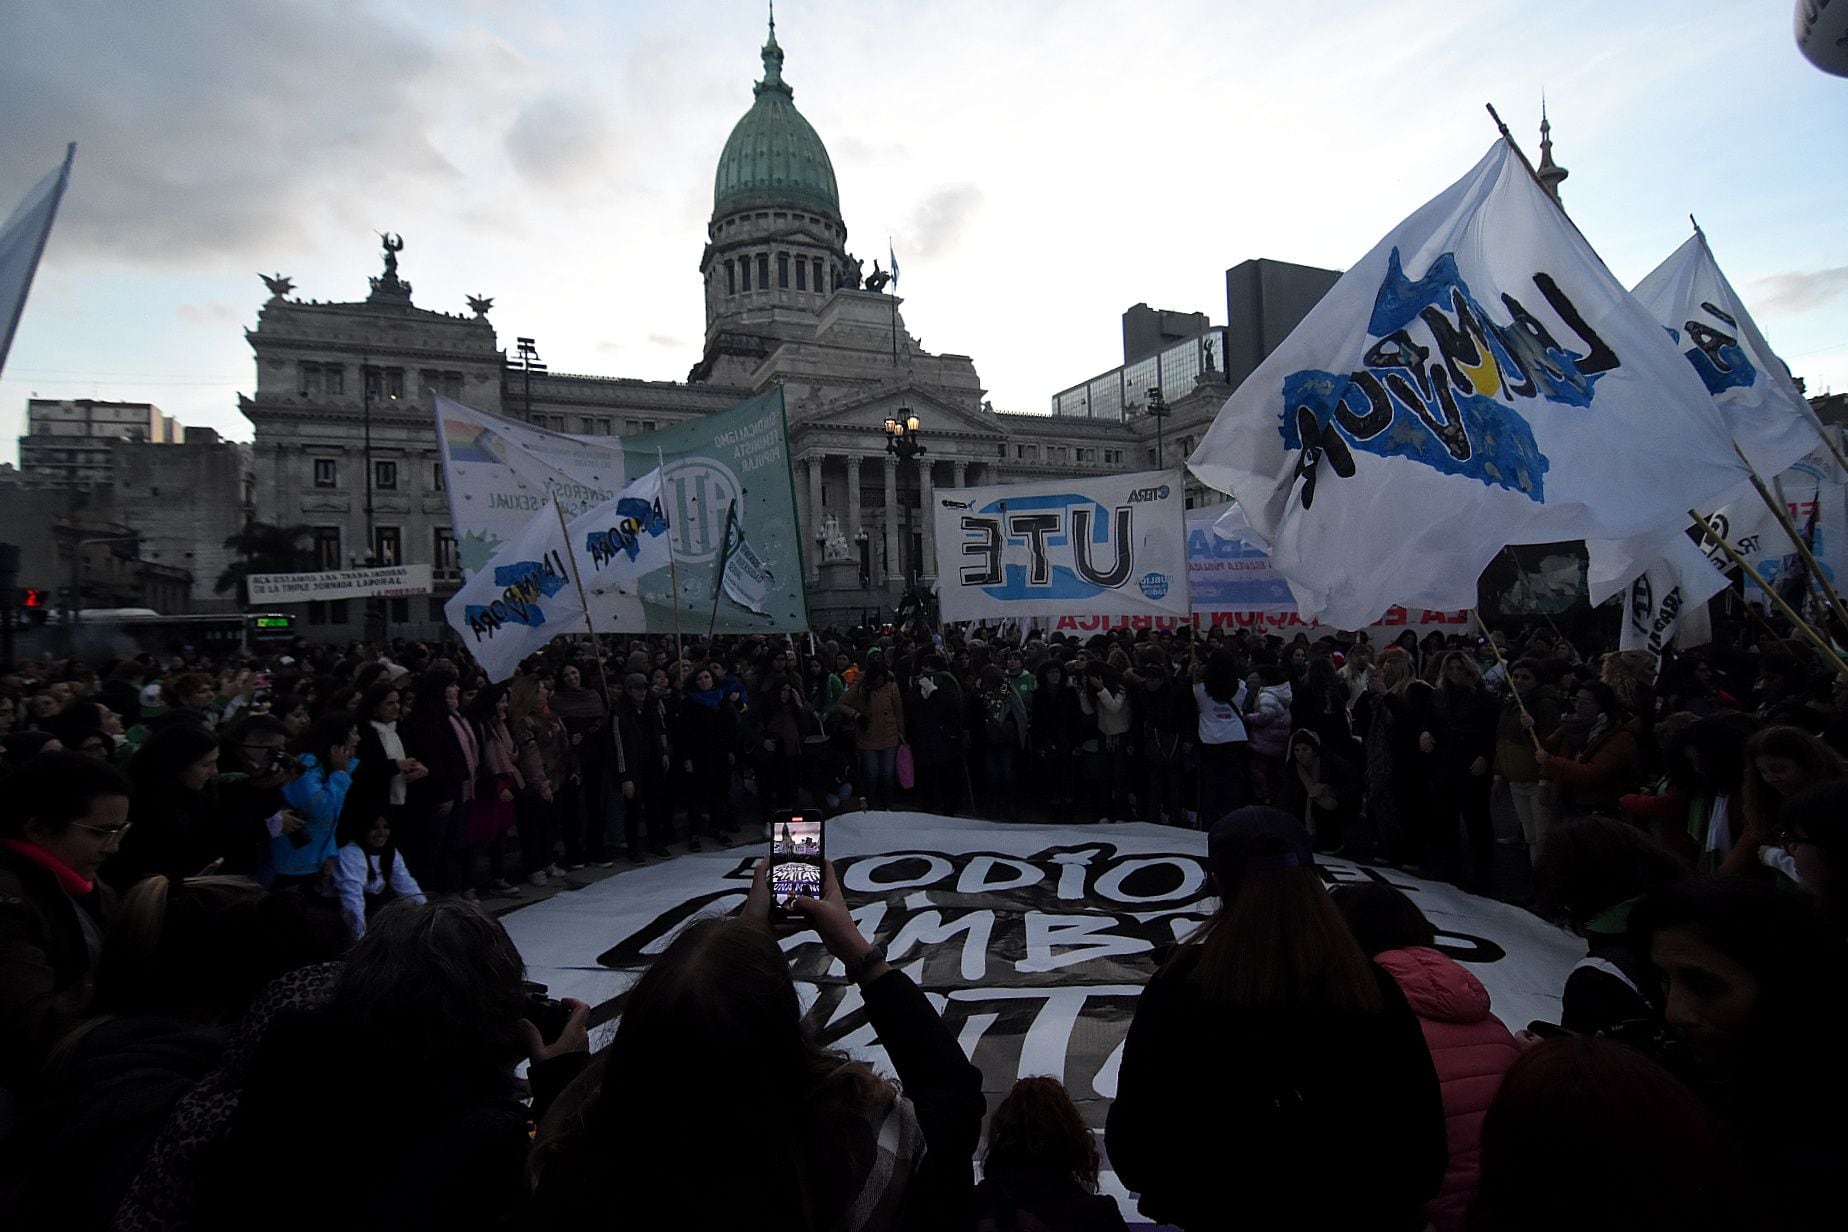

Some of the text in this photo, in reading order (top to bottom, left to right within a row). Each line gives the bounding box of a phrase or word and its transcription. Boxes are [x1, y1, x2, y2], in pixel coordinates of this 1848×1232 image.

[313, 581, 352, 591] JORNADA
[843, 849, 1207, 903] ODIO
[774, 883, 792, 892] UNA
